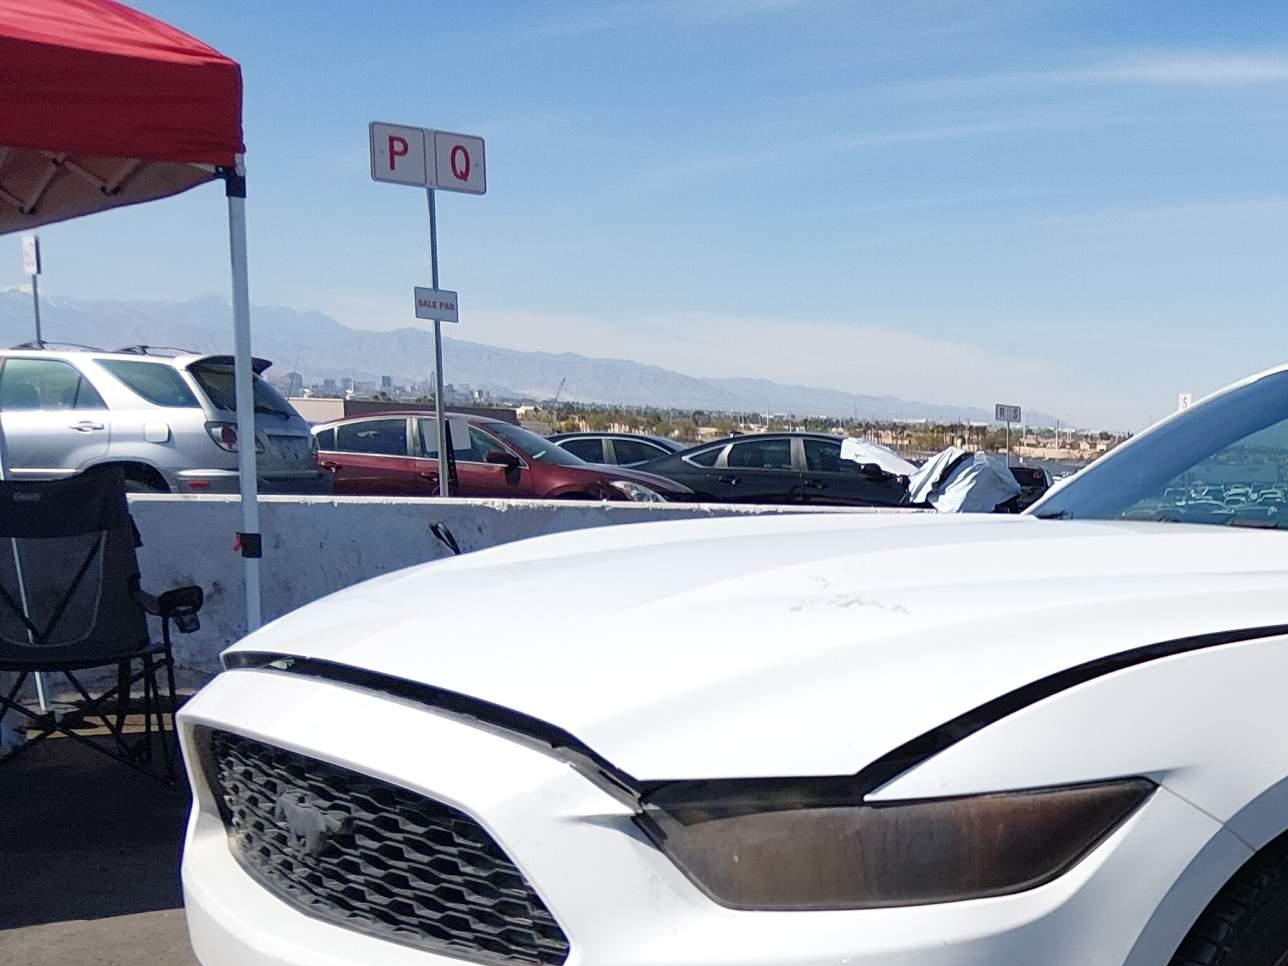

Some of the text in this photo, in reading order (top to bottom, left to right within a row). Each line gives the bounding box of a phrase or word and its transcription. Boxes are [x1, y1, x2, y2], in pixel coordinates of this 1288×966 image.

[388, 135, 471, 182] P Q
[1012, 408, 1019, 420] S
